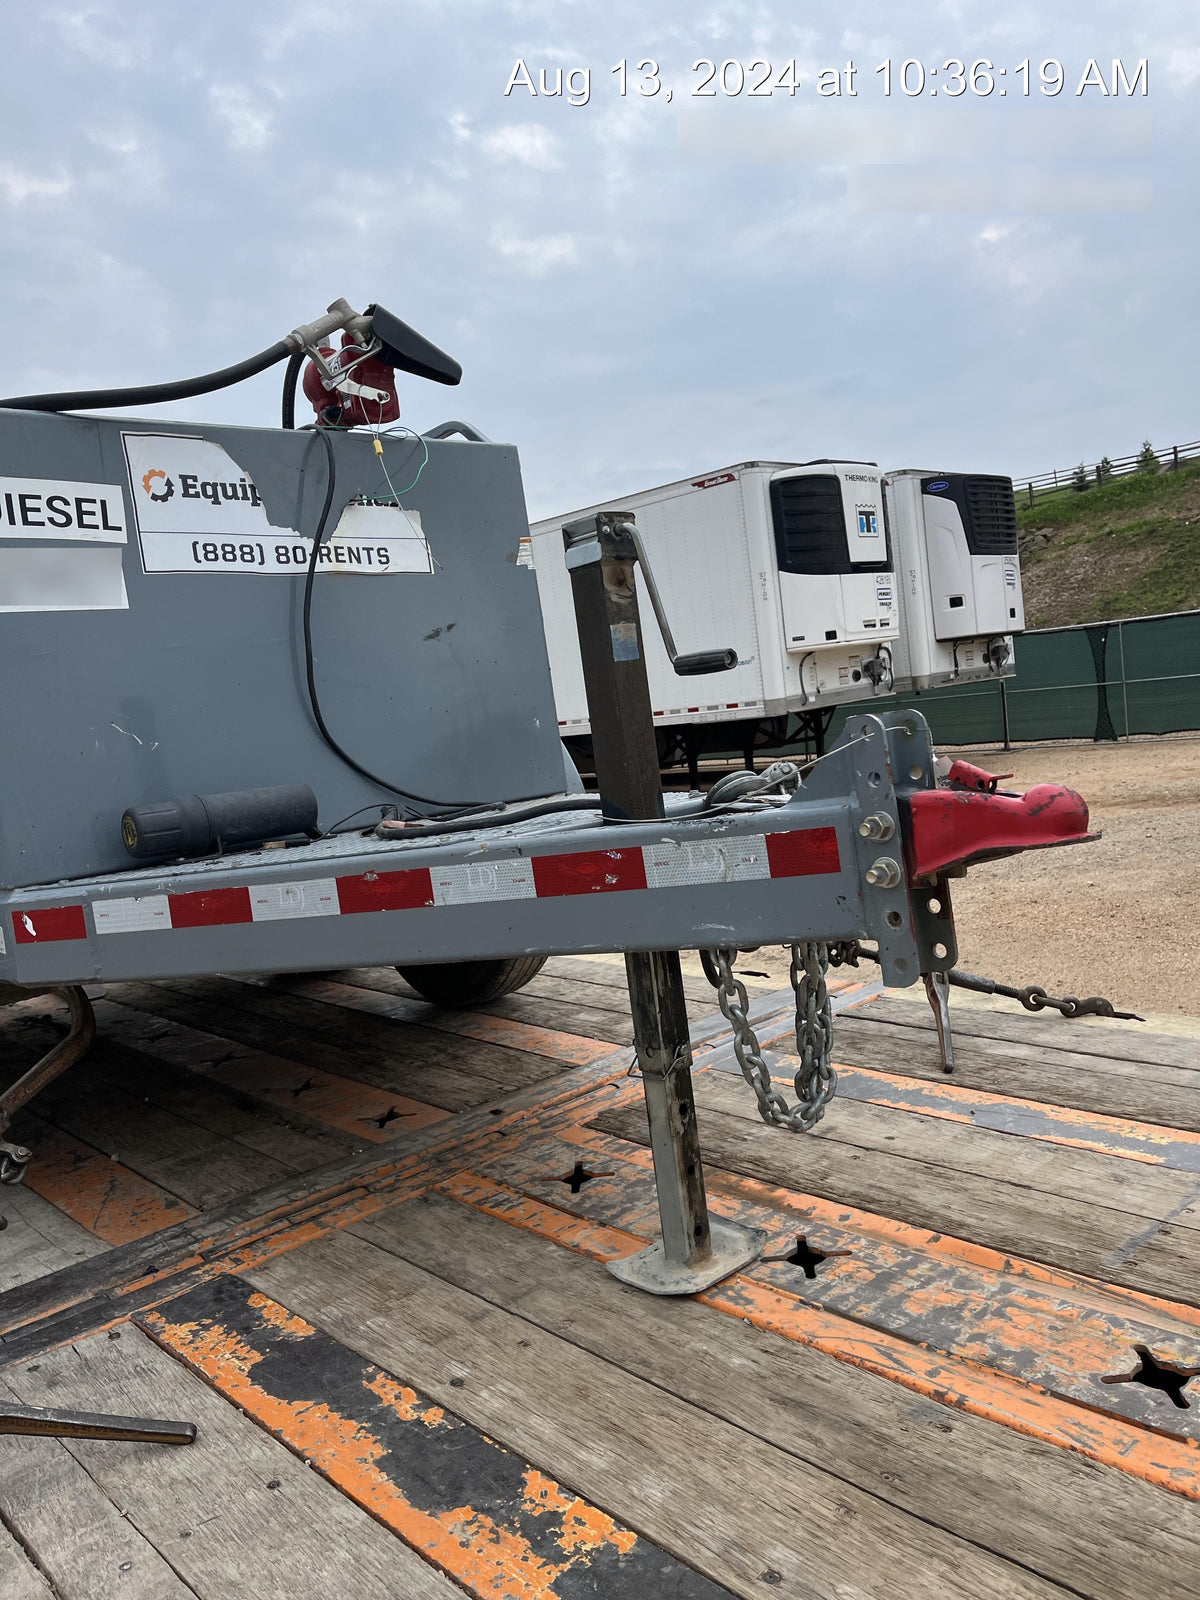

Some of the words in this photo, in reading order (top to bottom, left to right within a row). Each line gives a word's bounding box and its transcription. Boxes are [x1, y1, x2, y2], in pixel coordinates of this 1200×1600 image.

[844, 474, 868, 482] THERMO
[0, 493, 122, 531] IESEL
[191, 541, 265, 566] (888)
